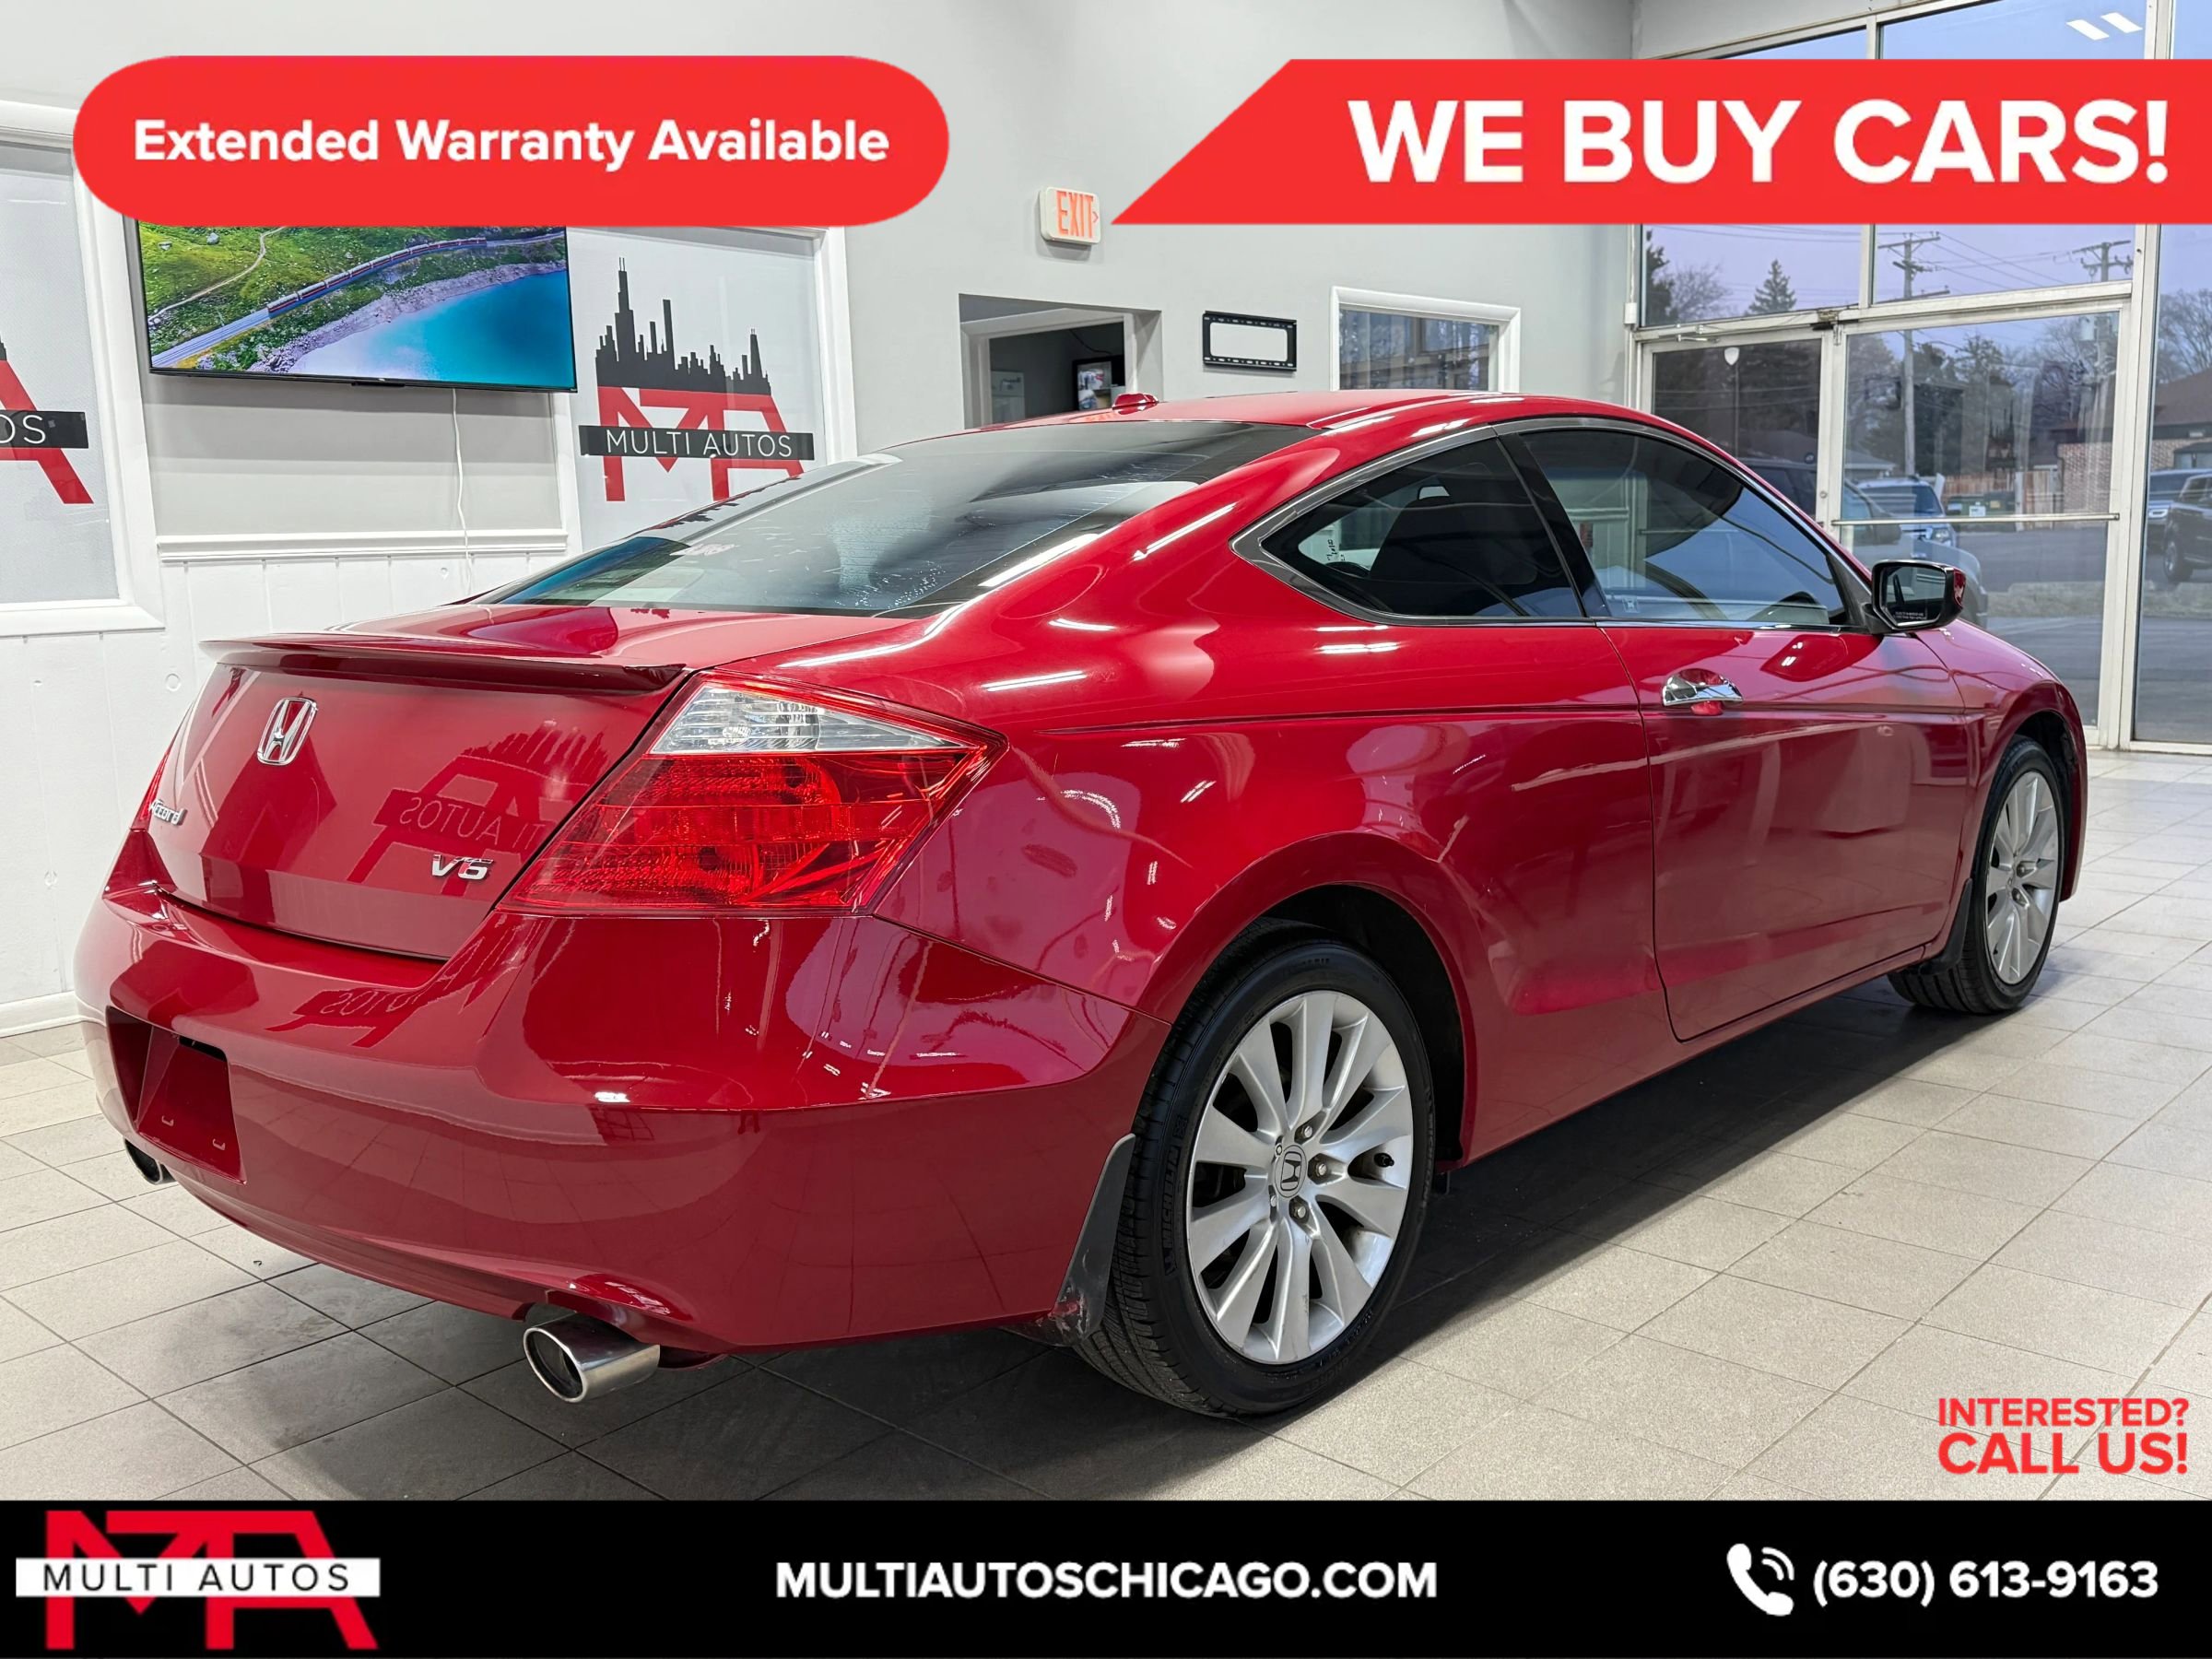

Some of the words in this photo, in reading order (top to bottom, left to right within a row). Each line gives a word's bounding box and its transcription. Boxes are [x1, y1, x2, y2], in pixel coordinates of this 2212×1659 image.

[1055, 190, 1094, 239] EXIT
[606, 429, 690, 455] MULTI
[702, 432, 793, 458] AUTOS
[431, 853, 494, 880] V6
[1161, 1147, 1182, 1249] MICHELIN
